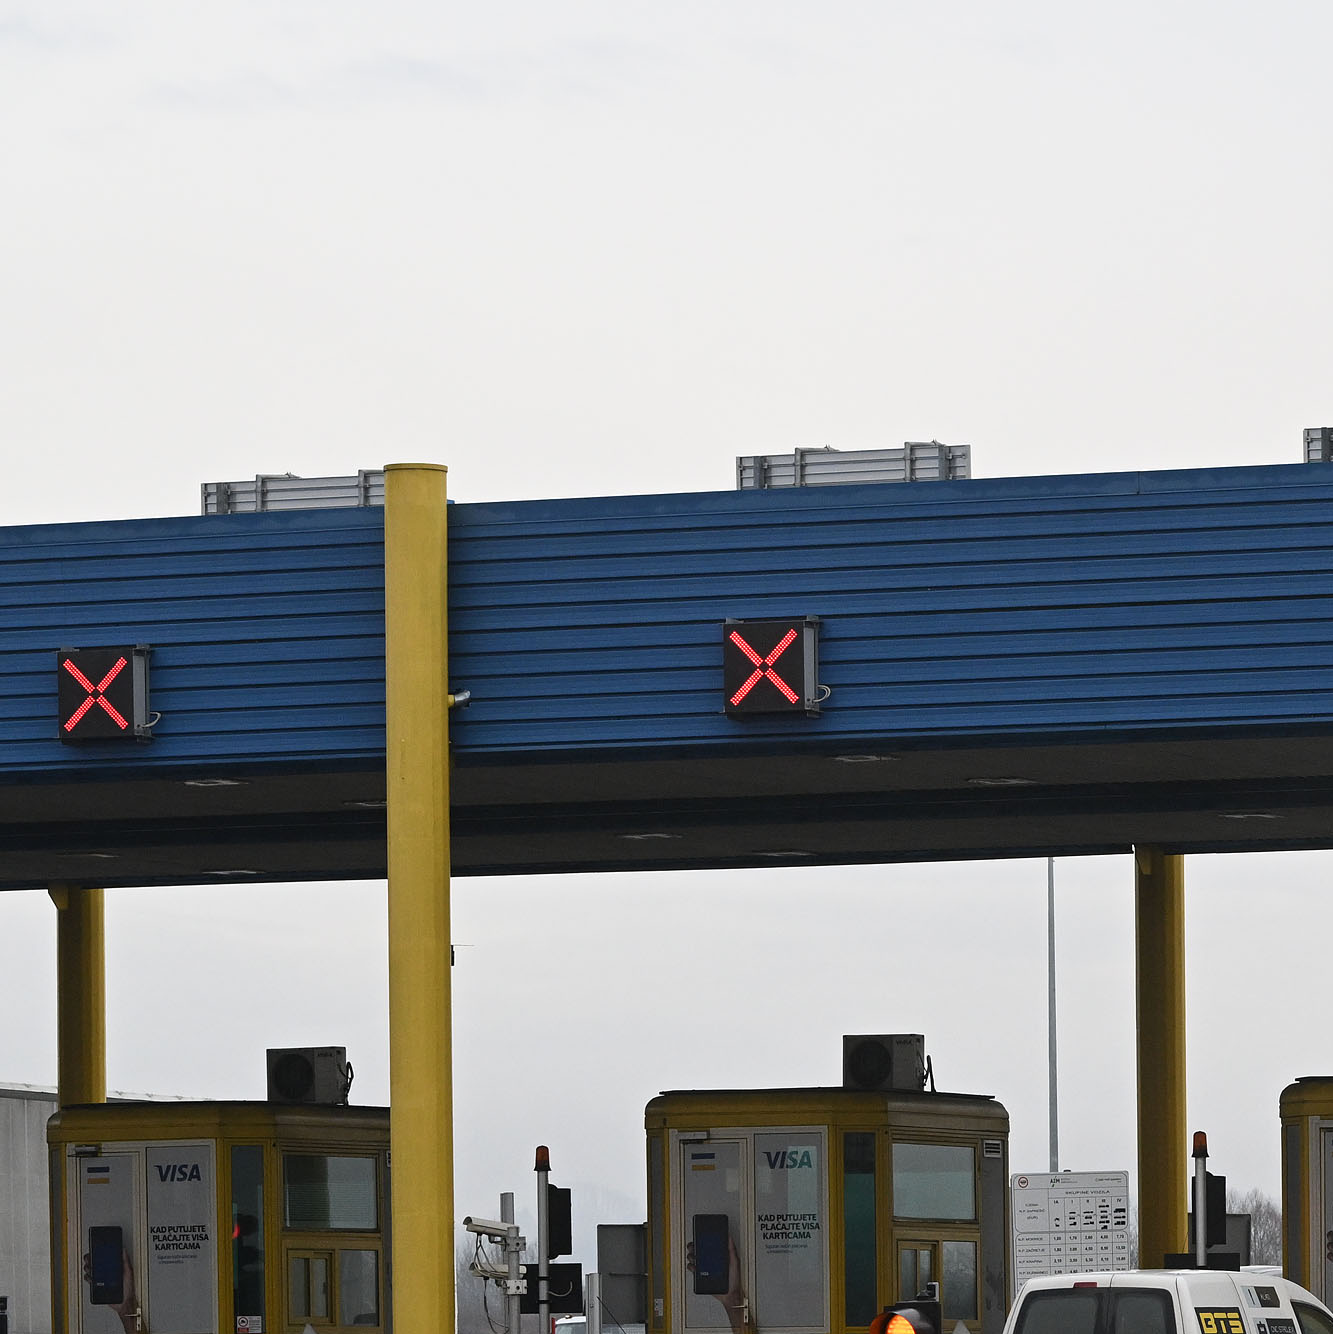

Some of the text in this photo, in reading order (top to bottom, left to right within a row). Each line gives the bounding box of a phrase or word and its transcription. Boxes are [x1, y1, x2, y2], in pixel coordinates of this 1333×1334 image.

[762, 1151, 812, 1169] VISA
[153, 1164, 201, 1182] VISA
[758, 1213, 817, 1222] KAD PUTUJETE
[150, 1225, 206, 1234] KAD PUTUJETE
[802, 1222, 820, 1230] VISA
[763, 1231, 812, 1240] KARTICAMA
[155, 1243, 200, 1251] KARTICAMA
[1199, 1312, 1244, 1334] BTS
